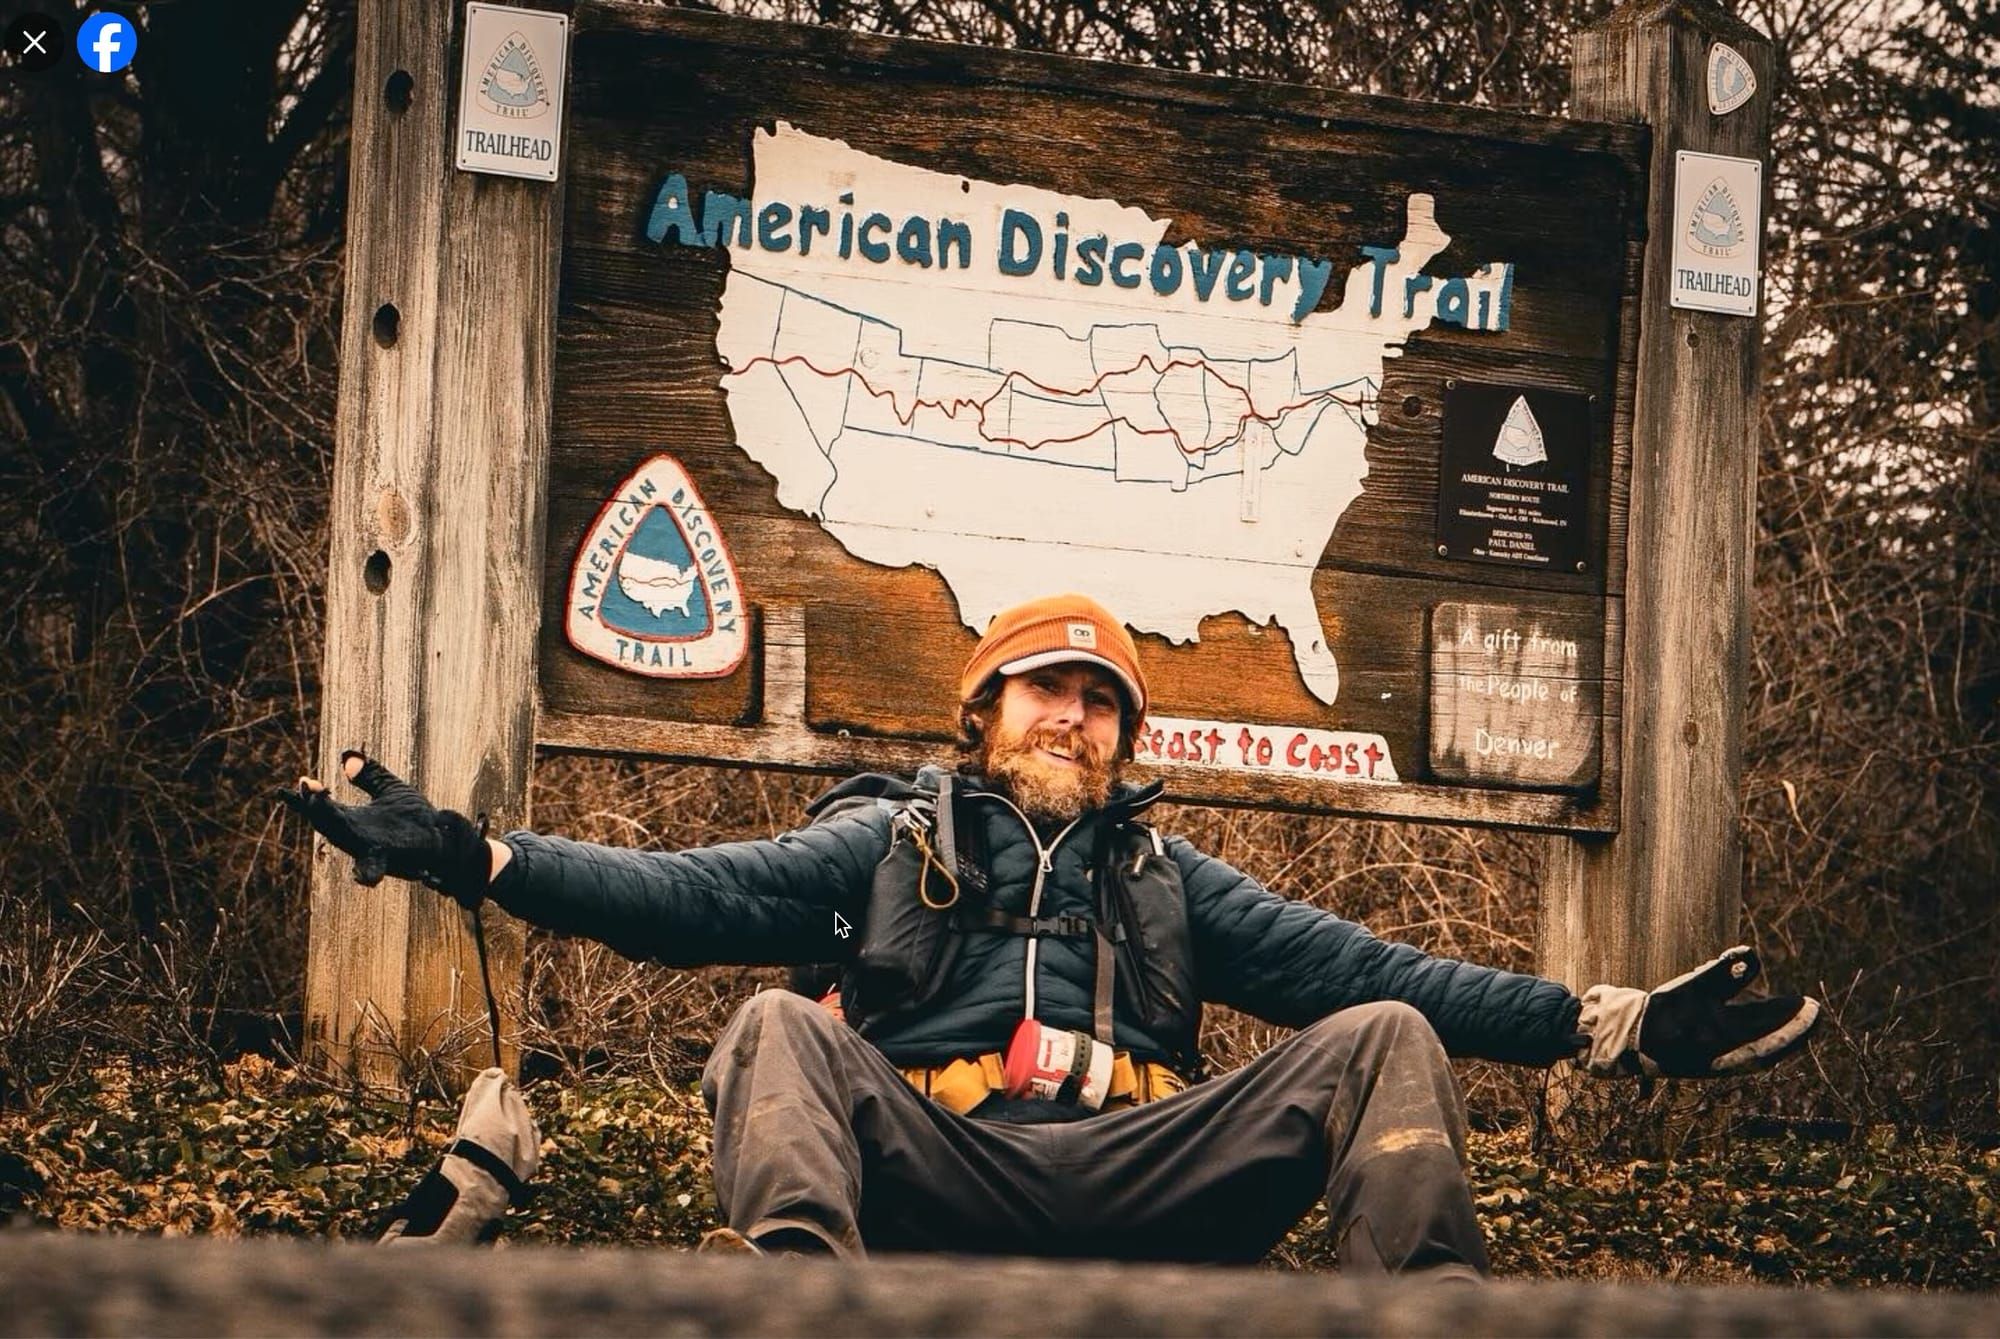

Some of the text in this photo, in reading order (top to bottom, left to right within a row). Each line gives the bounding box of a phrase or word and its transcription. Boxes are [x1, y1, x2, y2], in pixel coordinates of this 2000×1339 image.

[480, 39, 546, 102] AMERICAN DISCOVERY
[496, 105, 529, 118] TRAIL
[466, 130, 552, 161] TRAILHEAD
[1689, 184, 1745, 242] AMERICAN DISCOVERY
[646, 171, 1515, 332] American Discovery Trail
[1702, 245, 1730, 257] TRAIL
[1677, 269, 1752, 297] TRAILHEAD
[1461, 474, 1569, 493] AMERICAN DISCOVERY TRAIL
[579, 478, 737, 634] AMERICAN DISCOVERY
[1488, 538, 1536, 551] PAUL DANIEL
[616, 638, 693, 668] TRAIL
[1460, 628, 1578, 658] A gift from
[1488, 674, 1549, 704] People
[1560, 686, 1578, 704] of
[1237, 727, 1273, 766] to
[1286, 733, 1385, 777] Coast
[1475, 728, 1561, 759] Denver
